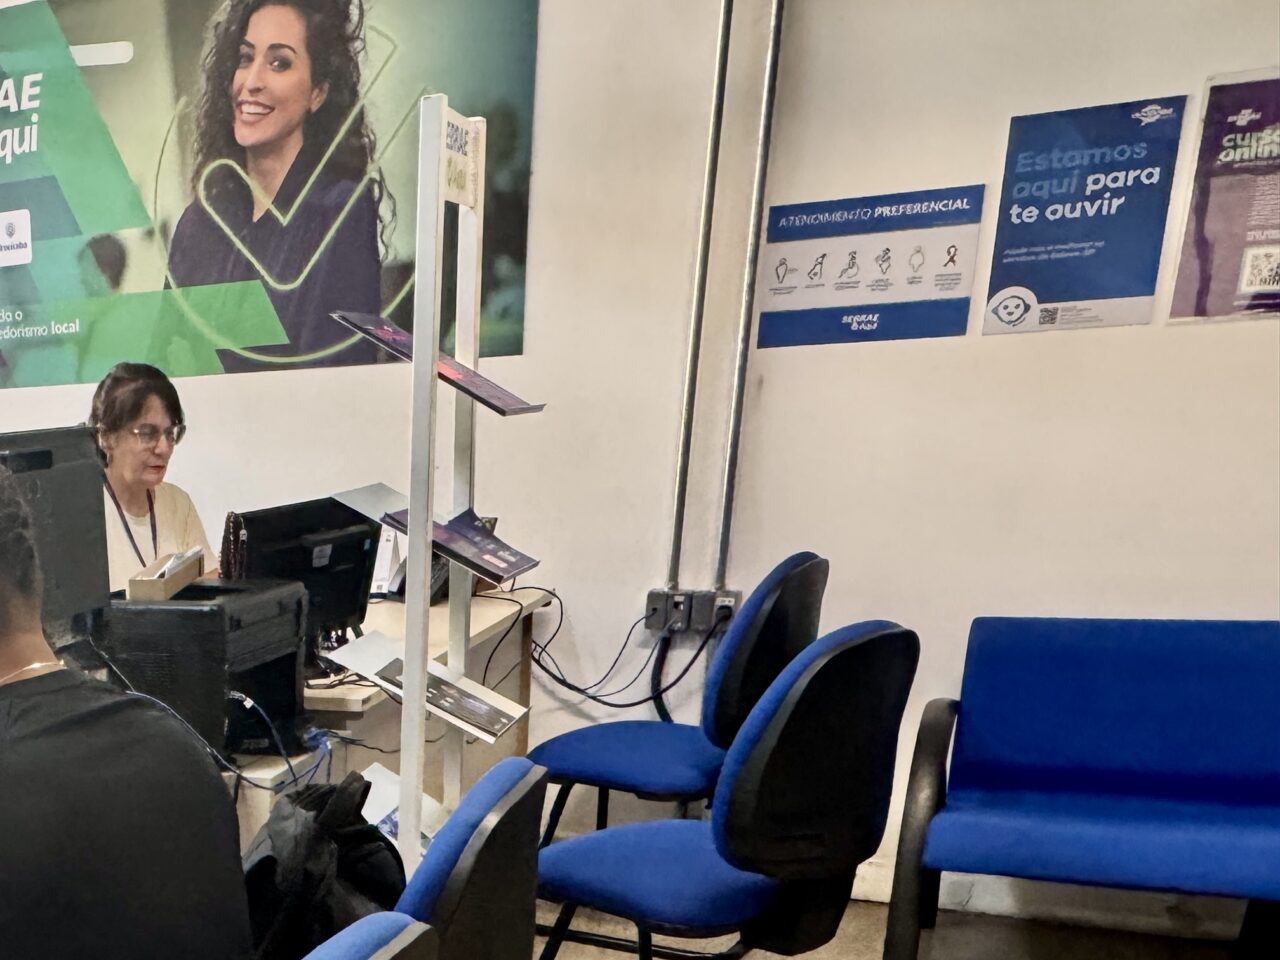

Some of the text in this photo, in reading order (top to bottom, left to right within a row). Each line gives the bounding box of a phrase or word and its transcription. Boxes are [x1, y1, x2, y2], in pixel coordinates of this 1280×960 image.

[1015, 142, 1147, 173] Estamos
[1012, 167, 1160, 199] aqui para
[778, 198, 970, 227] ATENDIMENTO PREFERENCIAL
[1010, 192, 1125, 224] te ouvir
[15, 311, 22, 320] o
[51, 319, 79, 335] local
